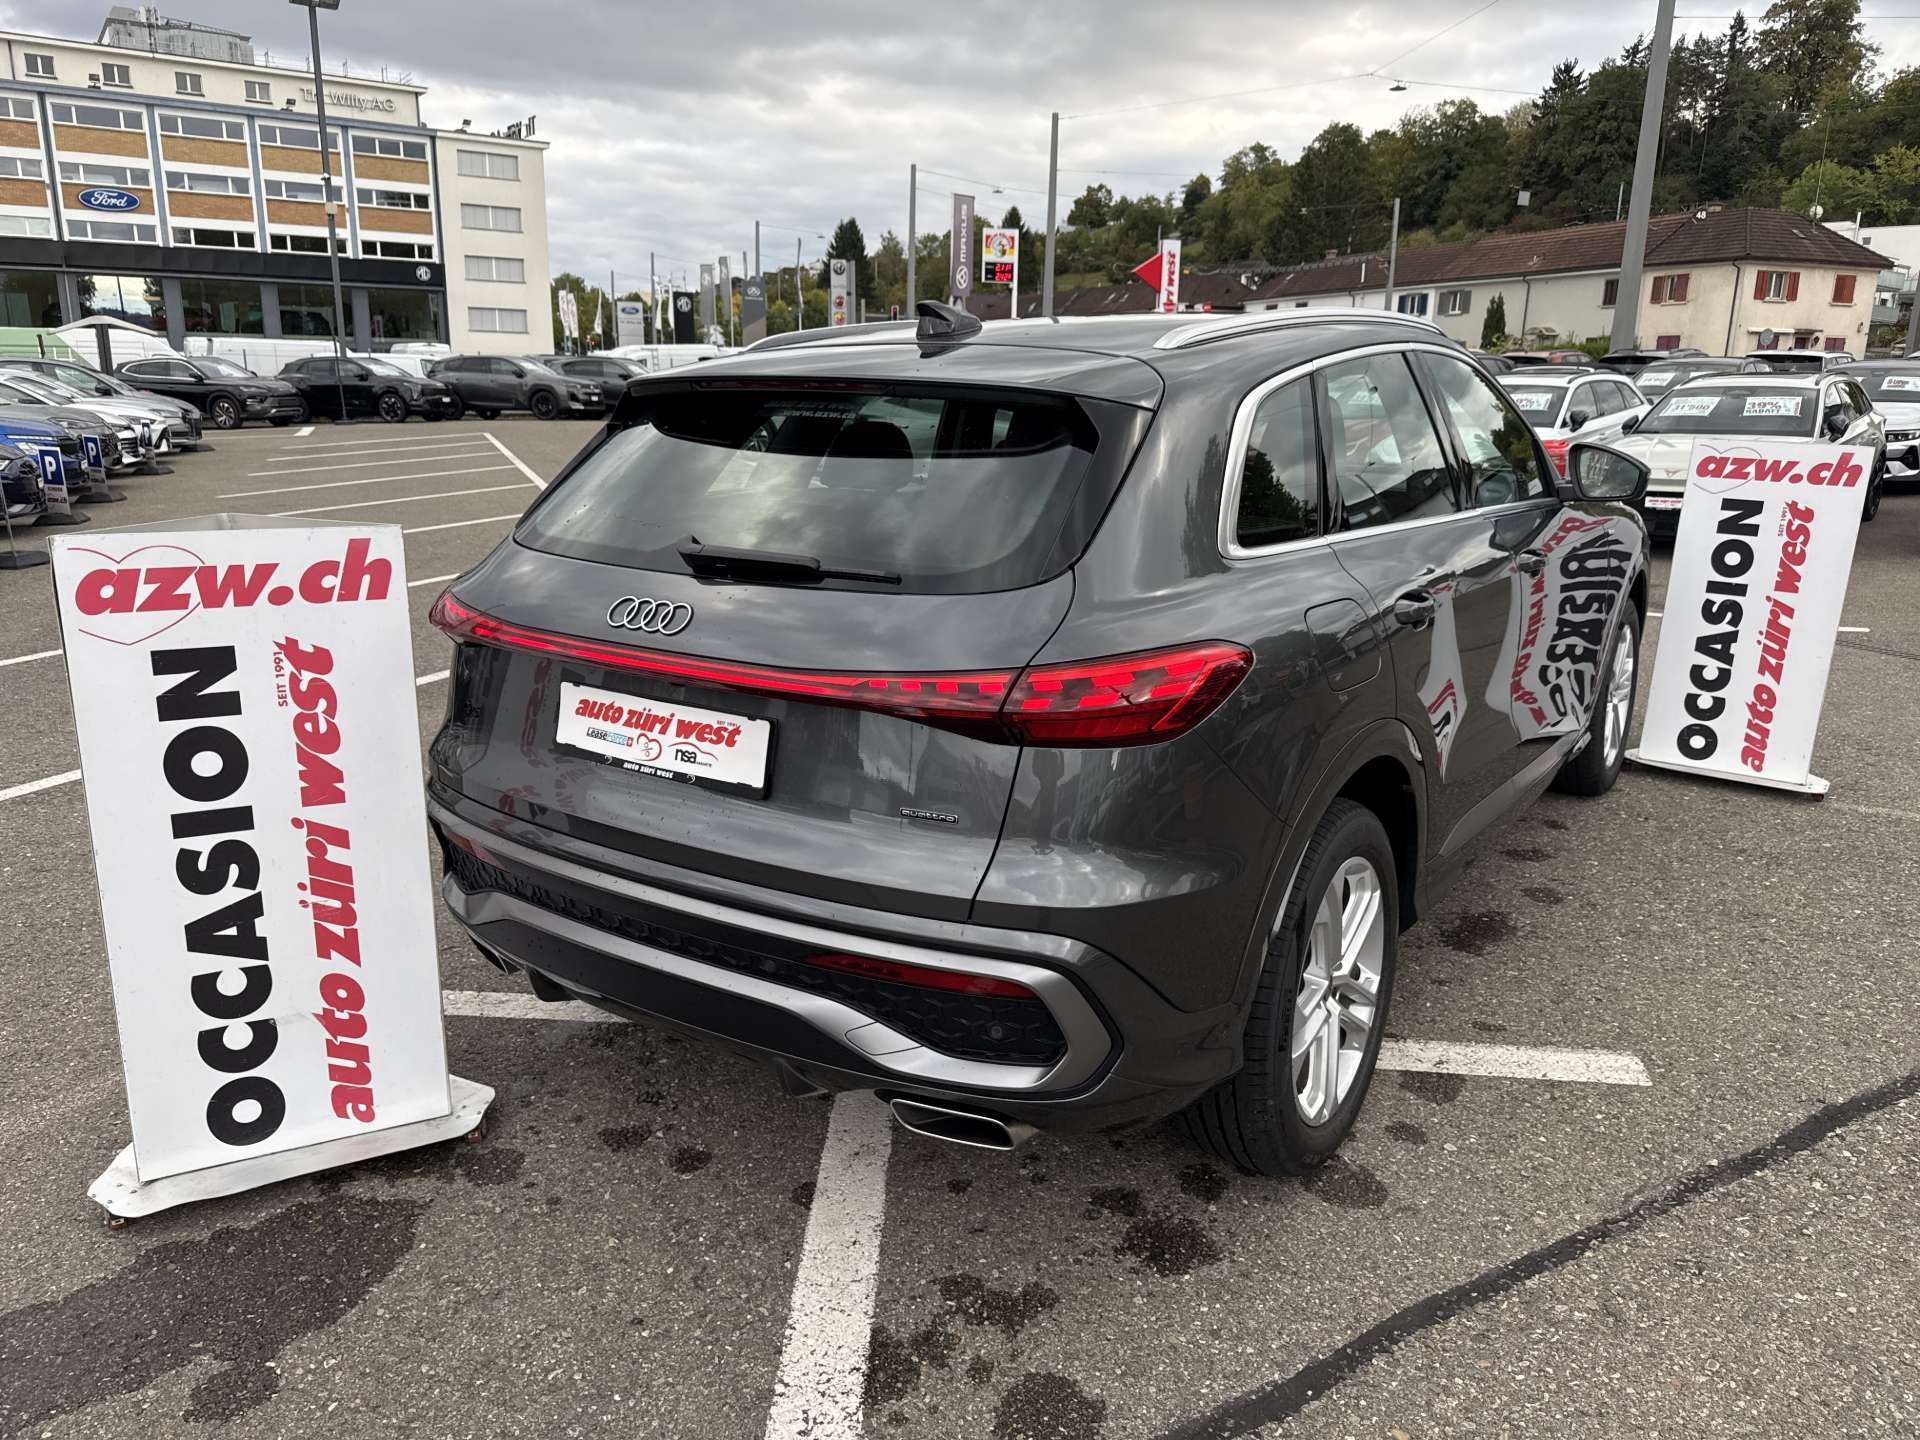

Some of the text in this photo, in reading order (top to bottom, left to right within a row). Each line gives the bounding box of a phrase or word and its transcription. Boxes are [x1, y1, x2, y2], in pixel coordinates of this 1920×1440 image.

[331, 91, 368, 112] Willy
[372, 97, 396, 112] AG
[90, 189, 128, 208] Ford
[44, 455, 56, 480] P
[87, 442, 97, 463] P
[1695, 452, 1863, 487] azw.ch
[75, 538, 392, 615] azw.ch
[1677, 498, 1764, 760] OCCASION
[1741, 500, 1815, 773] auto züri west
[273, 651, 288, 707] SEIT 1991
[575, 698, 742, 748] auto züri west
[623, 761, 674, 778] auto züri west
[675, 748, 698, 764] nsa
[902, 810, 955, 822] quattro
[150, 645, 286, 1146] OCCASION
[273, 636, 375, 1123] auto züri west
